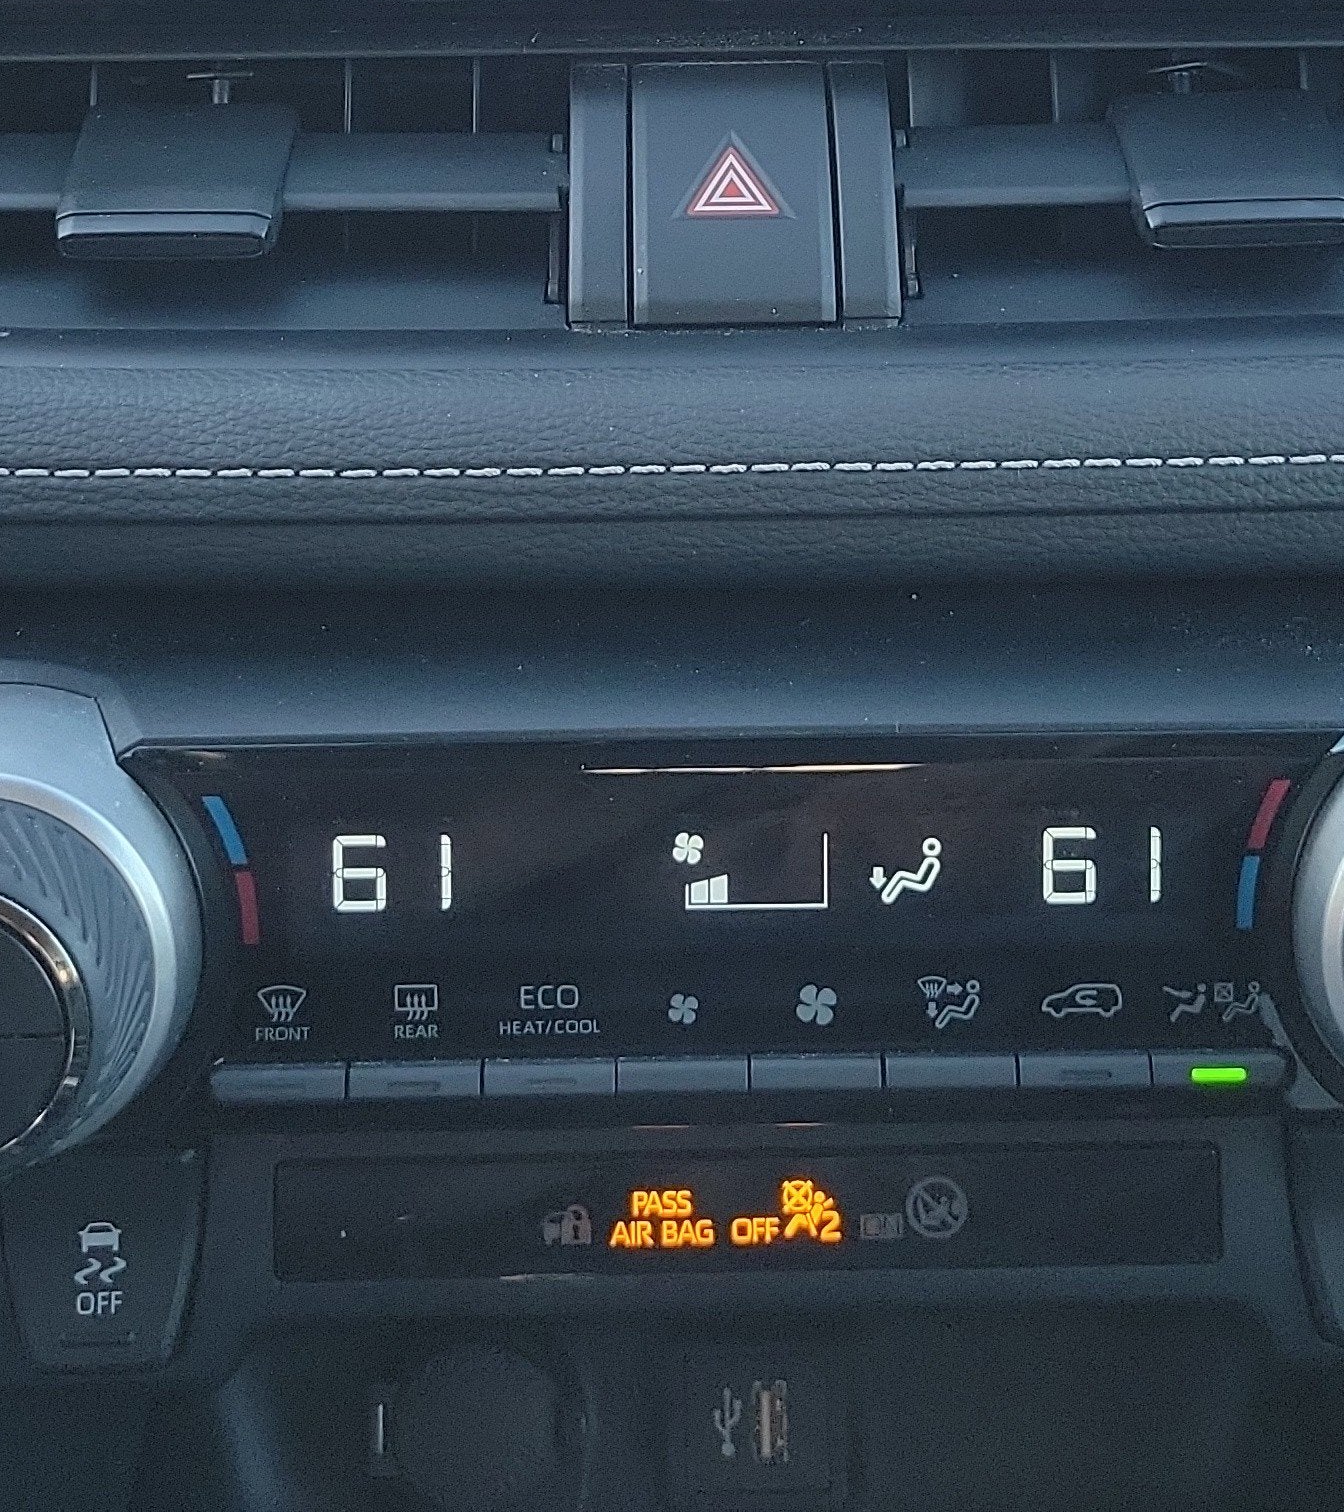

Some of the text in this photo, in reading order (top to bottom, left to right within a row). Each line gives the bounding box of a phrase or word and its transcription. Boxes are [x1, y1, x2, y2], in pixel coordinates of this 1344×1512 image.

[331, 834, 453, 913] 61
[1042, 826, 1162, 905] 61
[519, 984, 580, 1011] ECO
[254, 1025, 311, 1042] FRONT
[393, 1022, 440, 1039] REAR
[498, 1018, 602, 1037] HEAT/COOL
[631, 1189, 693, 1218] PASS
[608, 1220, 654, 1247] AIR
[661, 1219, 715, 1246] BAG
[730, 1216, 780, 1245] OFF
[75, 1290, 124, 1316] OFF
